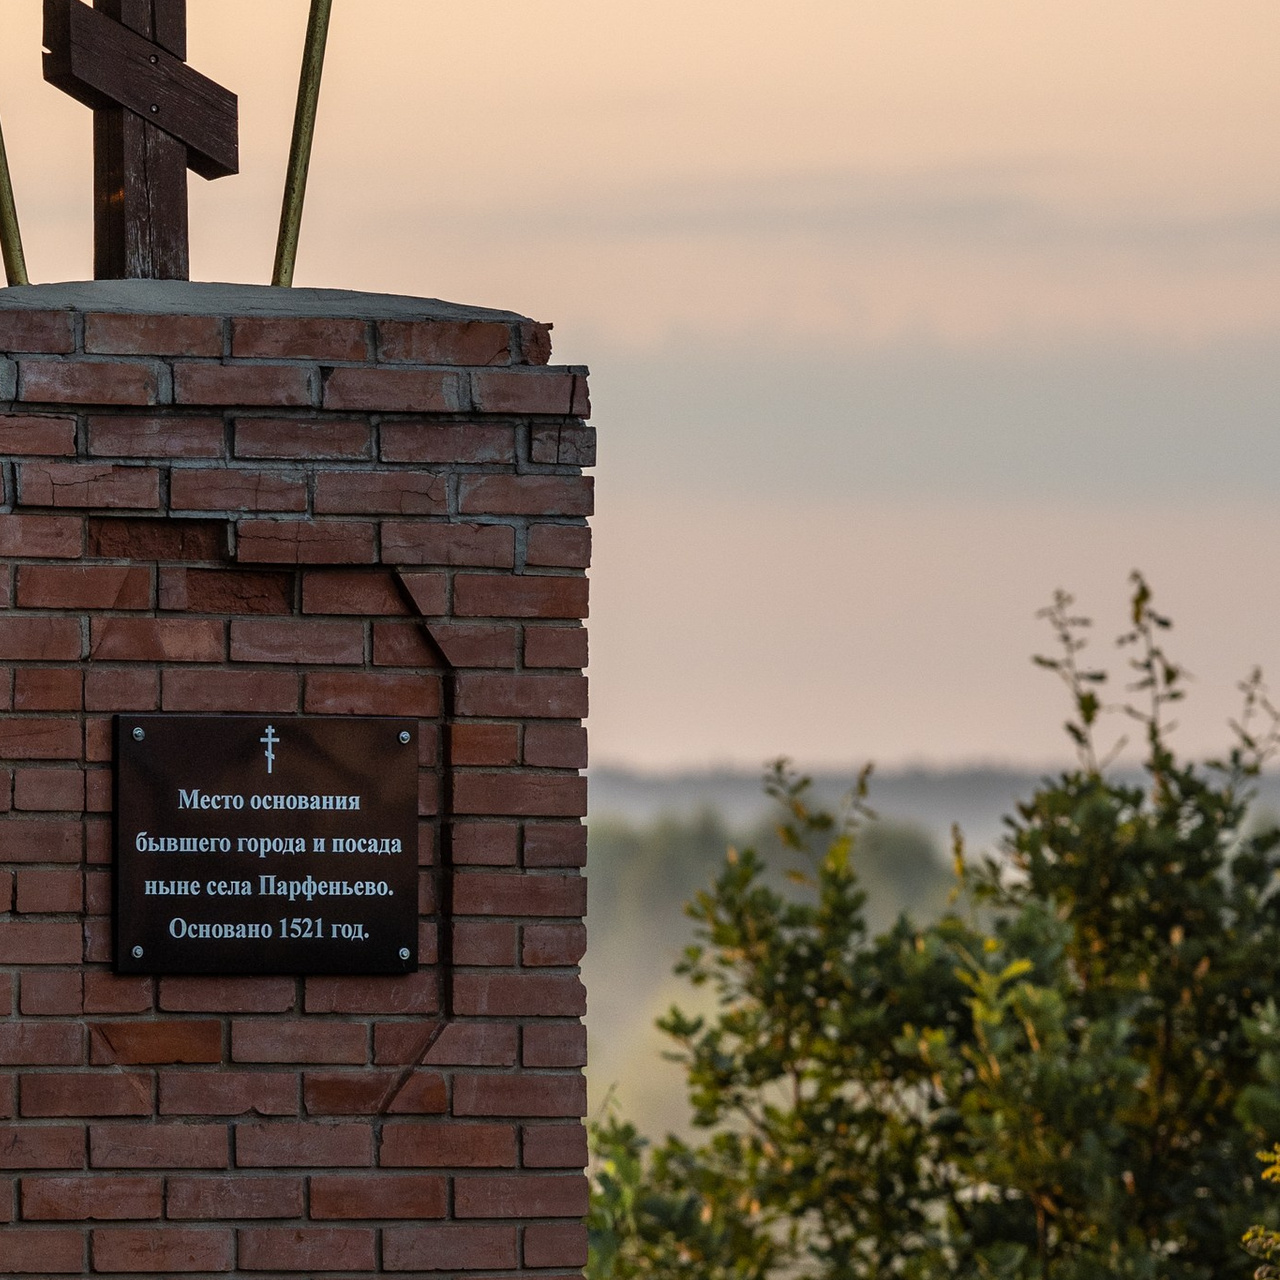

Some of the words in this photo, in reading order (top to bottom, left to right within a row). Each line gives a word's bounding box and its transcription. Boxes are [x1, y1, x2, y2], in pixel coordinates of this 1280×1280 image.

[178, 789, 244, 810] Место
[250, 795, 361, 811] основания
[135, 831, 231, 853] бывшего
[237, 838, 306, 858] города
[313, 838, 325, 853] и
[332, 838, 402, 855] посада
[144, 881, 201, 895] ныне
[206, 881, 252, 896] села
[258, 874, 394, 902] Парфеньево.
[168, 917, 273, 939] Основано
[279, 917, 324, 939] 1521
[331, 924, 370, 942] год.
